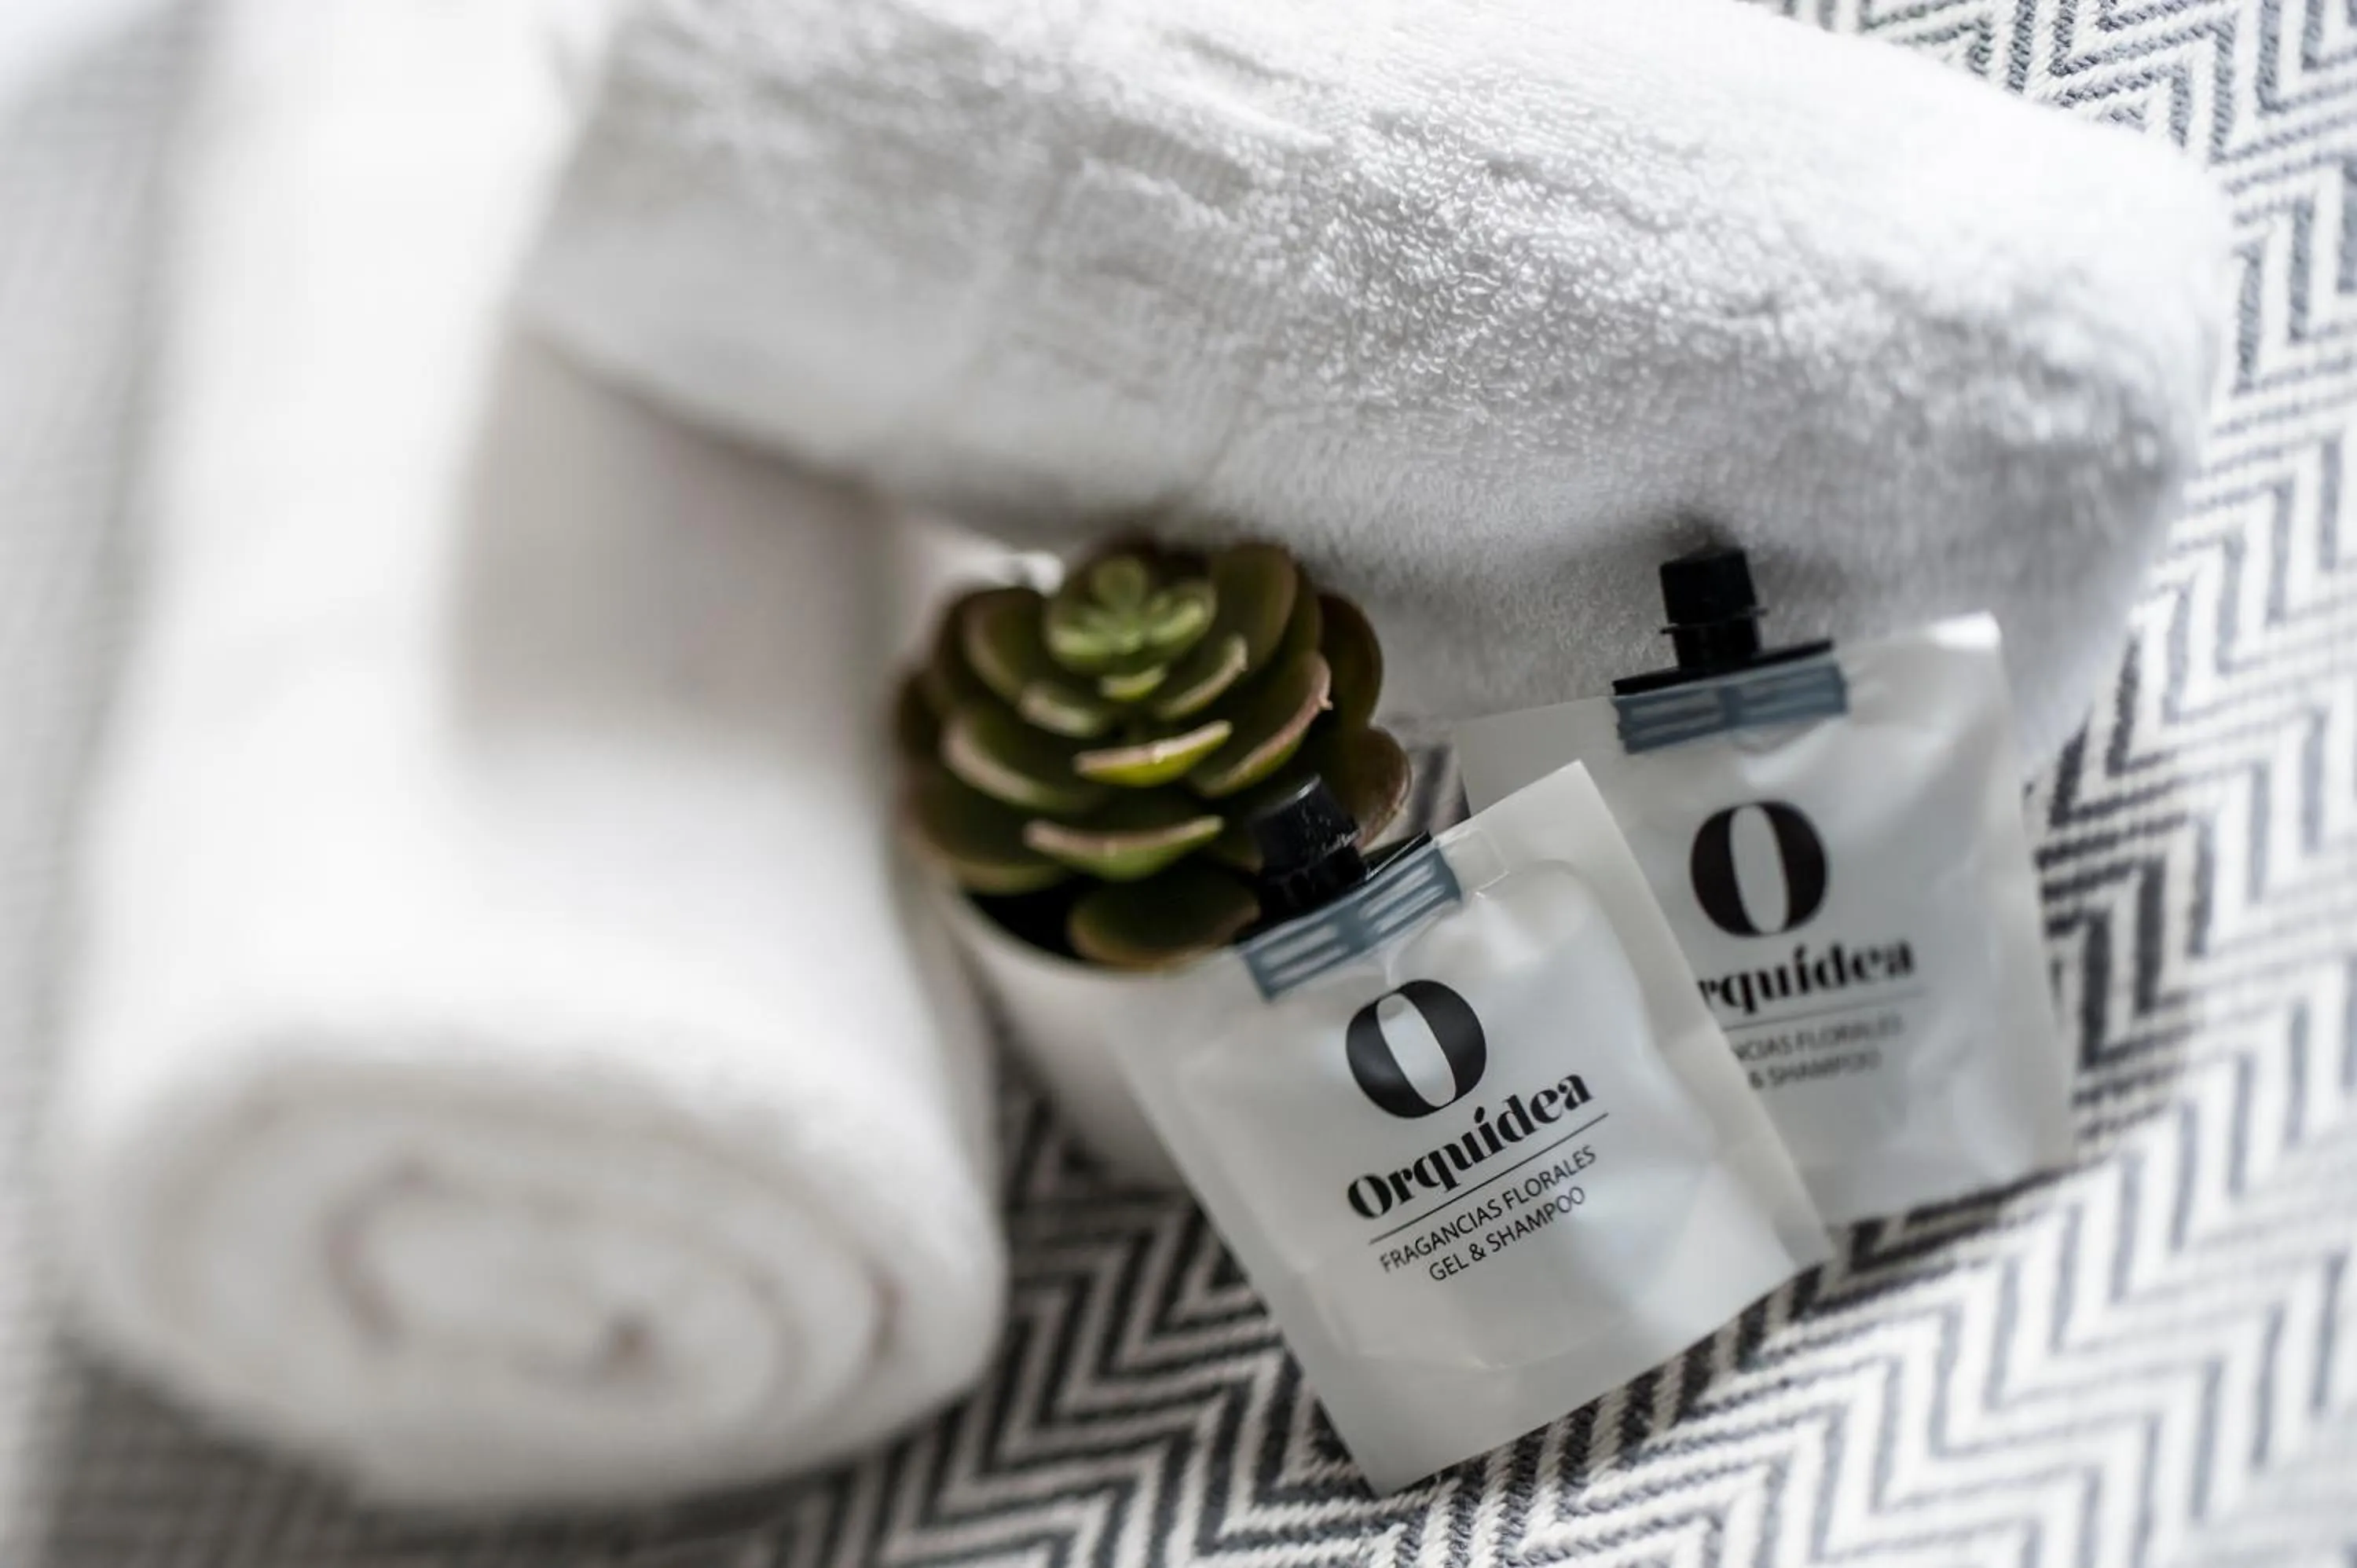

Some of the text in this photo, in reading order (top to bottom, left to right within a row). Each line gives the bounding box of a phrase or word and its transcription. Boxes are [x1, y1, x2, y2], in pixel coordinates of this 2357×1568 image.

[1691, 800, 1829, 937] O
[1698, 940, 1915, 1015] rquídea
[1346, 979, 1487, 1119] O
[1347, 1074, 1593, 1219] Orquídea
[1379, 1145, 1597, 1273] FRAGANCIAS FLORALES
[1429, 1186, 1585, 1281] GEL & SHAMPOO
